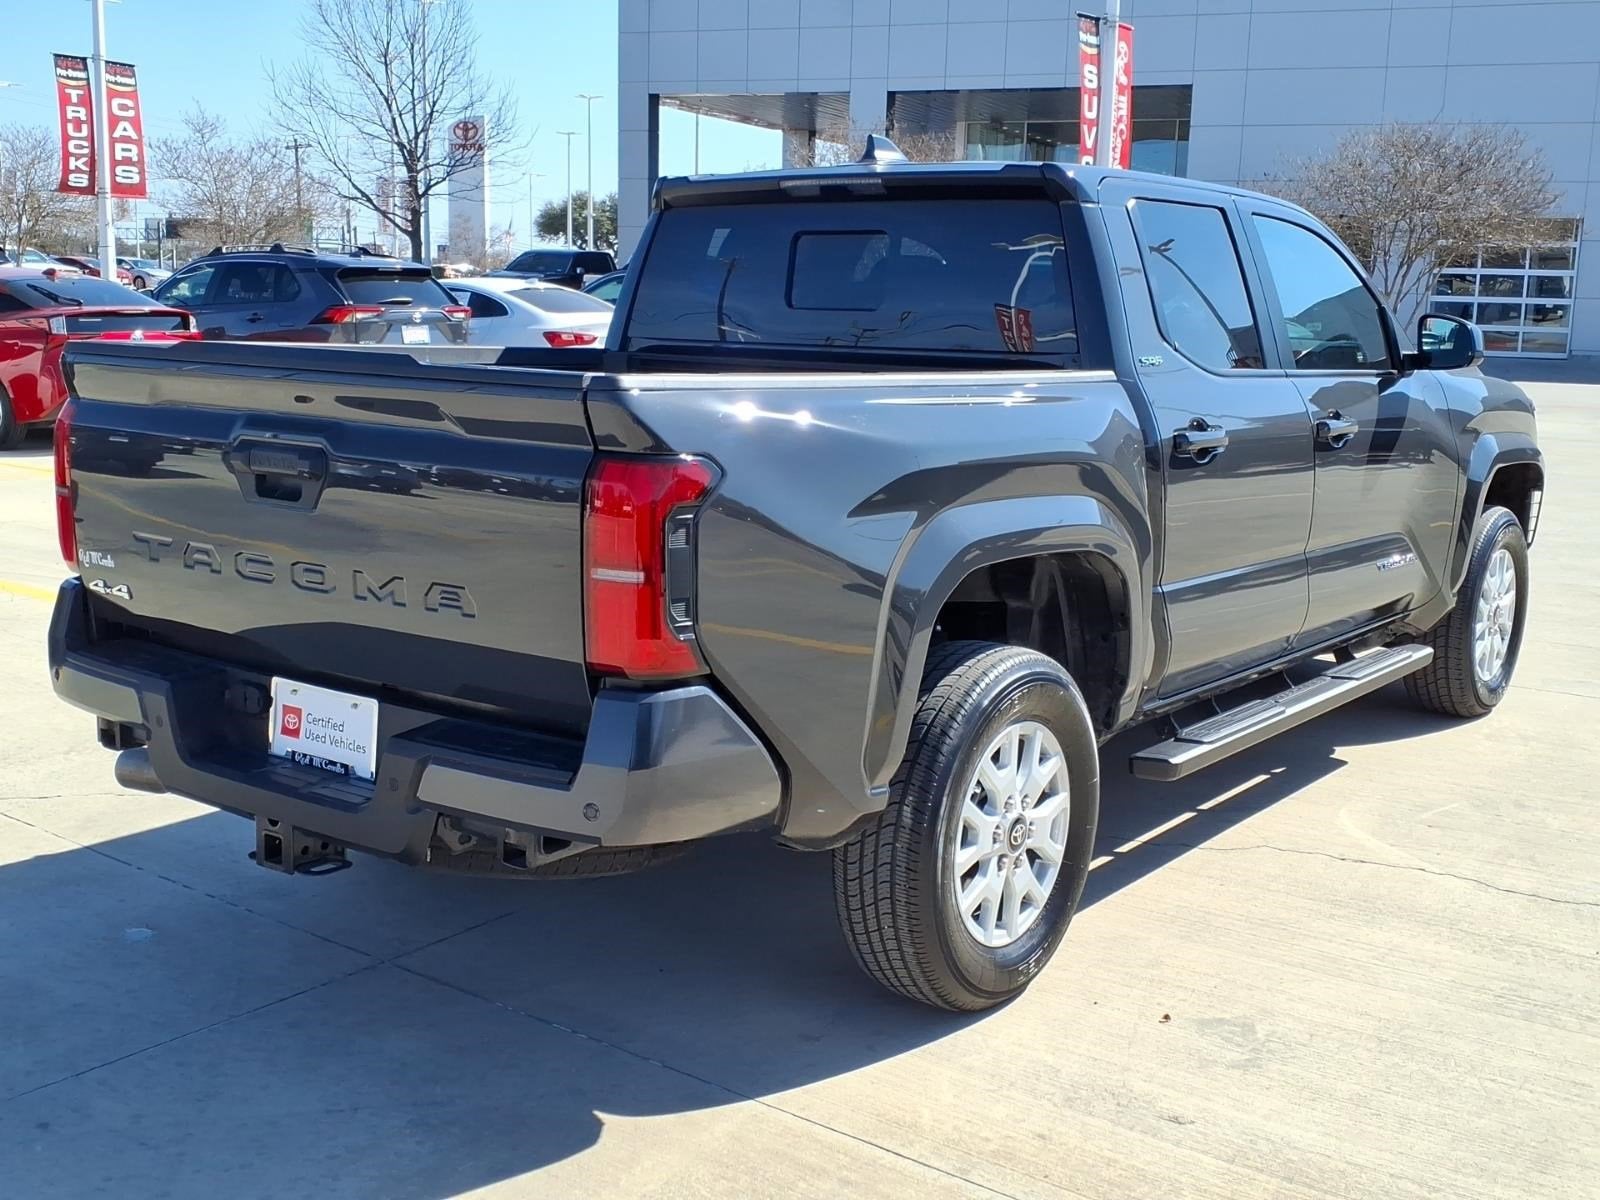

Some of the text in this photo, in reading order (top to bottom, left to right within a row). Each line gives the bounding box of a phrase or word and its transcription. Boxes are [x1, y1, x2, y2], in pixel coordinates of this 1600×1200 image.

[1117, 41, 1129, 87] Red
[64, 88, 90, 187] TRUCKS
[111, 97, 140, 184] CARS
[449, 143, 484, 152] TOYOTA
[79, 548, 91, 567] Red
[131, 530, 479, 619] TACOMA
[306, 712, 345, 733] Certified
[304, 728, 367, 754] Used Vehicles
[294, 751, 311, 767] Red
